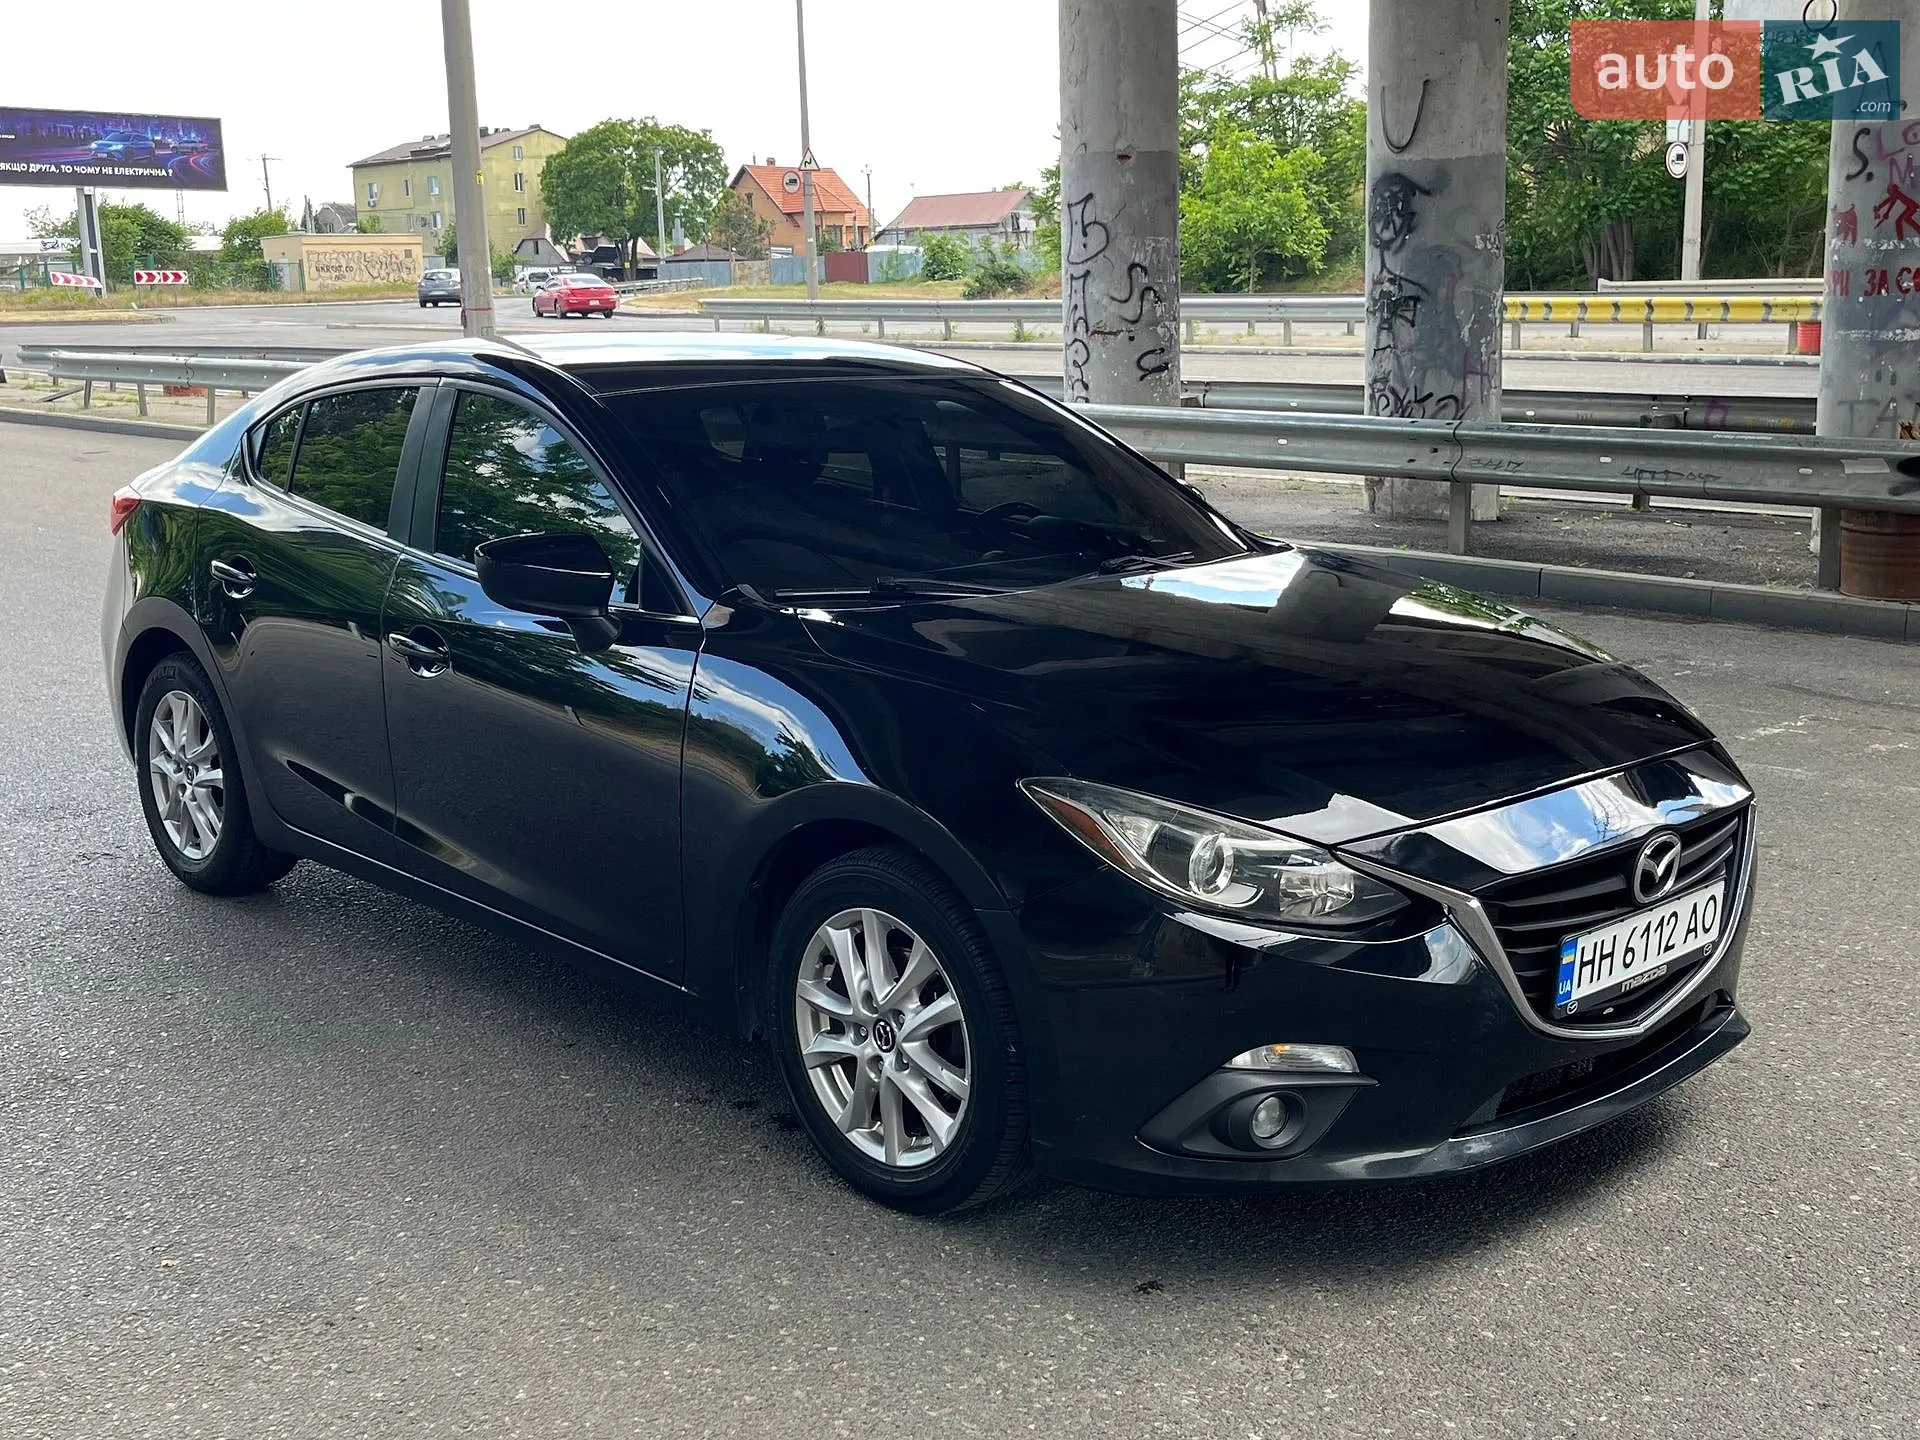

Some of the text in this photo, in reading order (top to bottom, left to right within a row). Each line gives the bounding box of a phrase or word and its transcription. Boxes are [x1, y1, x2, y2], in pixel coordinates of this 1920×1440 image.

[0, 162, 27, 172] ЯКЩО
[29, 163, 60, 174] ДРУГА,
[61, 165, 73, 173] ТО
[74, 165, 101, 174] ЧОМУ
[102, 166, 113, 175] НЕ
[114, 167, 167, 177] ЕЛЕКТРИЧНА
[1863, 268, 1890, 297] ЗА
[1576, 894, 1718, 989] HH 6112 AO
[1559, 980, 1571, 995] UA
[1621, 964, 1668, 993] mazda
